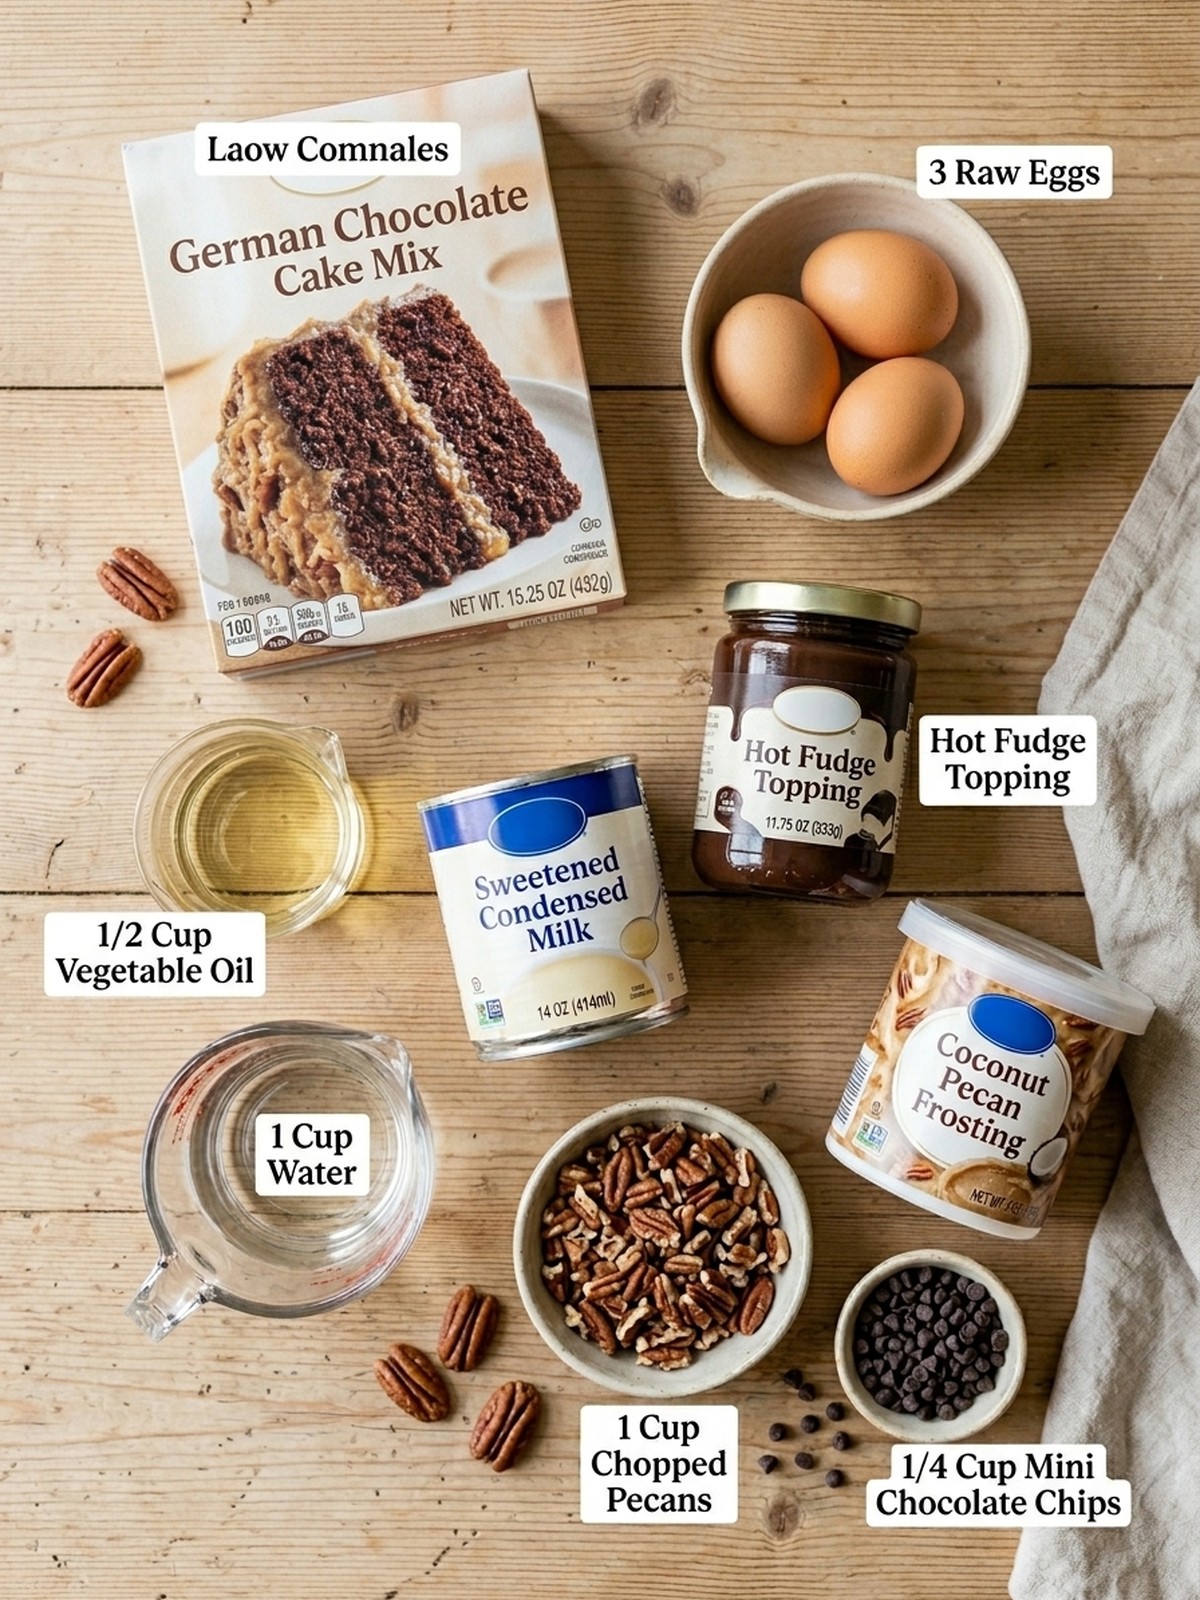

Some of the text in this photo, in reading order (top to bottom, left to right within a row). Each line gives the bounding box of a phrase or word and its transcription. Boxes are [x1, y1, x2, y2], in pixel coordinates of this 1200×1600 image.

[169, 185, 529, 274] German Chocolate
[274, 241, 443, 297] Cake Mix
[449, 596, 477, 618] NET
[506, 583, 545, 607] 15.25
[548, 579, 567, 600] OZ
[743, 739, 790, 767] Hot
[797, 744, 877, 781] Fudge
[753, 769, 864, 809] Topping
[765, 816, 793, 832] 11.75
[795, 818, 810, 833] OZ
[474, 846, 621, 901] Sweetened
[479, 875, 629, 930] Condensed
[526, 917, 595, 953] Milk
[537, 1005, 551, 1021] 14
[553, 1000, 570, 1017] OZ
[936, 1032, 1050, 1098] Coconut
[937, 1066, 1022, 1121] Pecan
[910, 1088, 1027, 1161] Frosting
